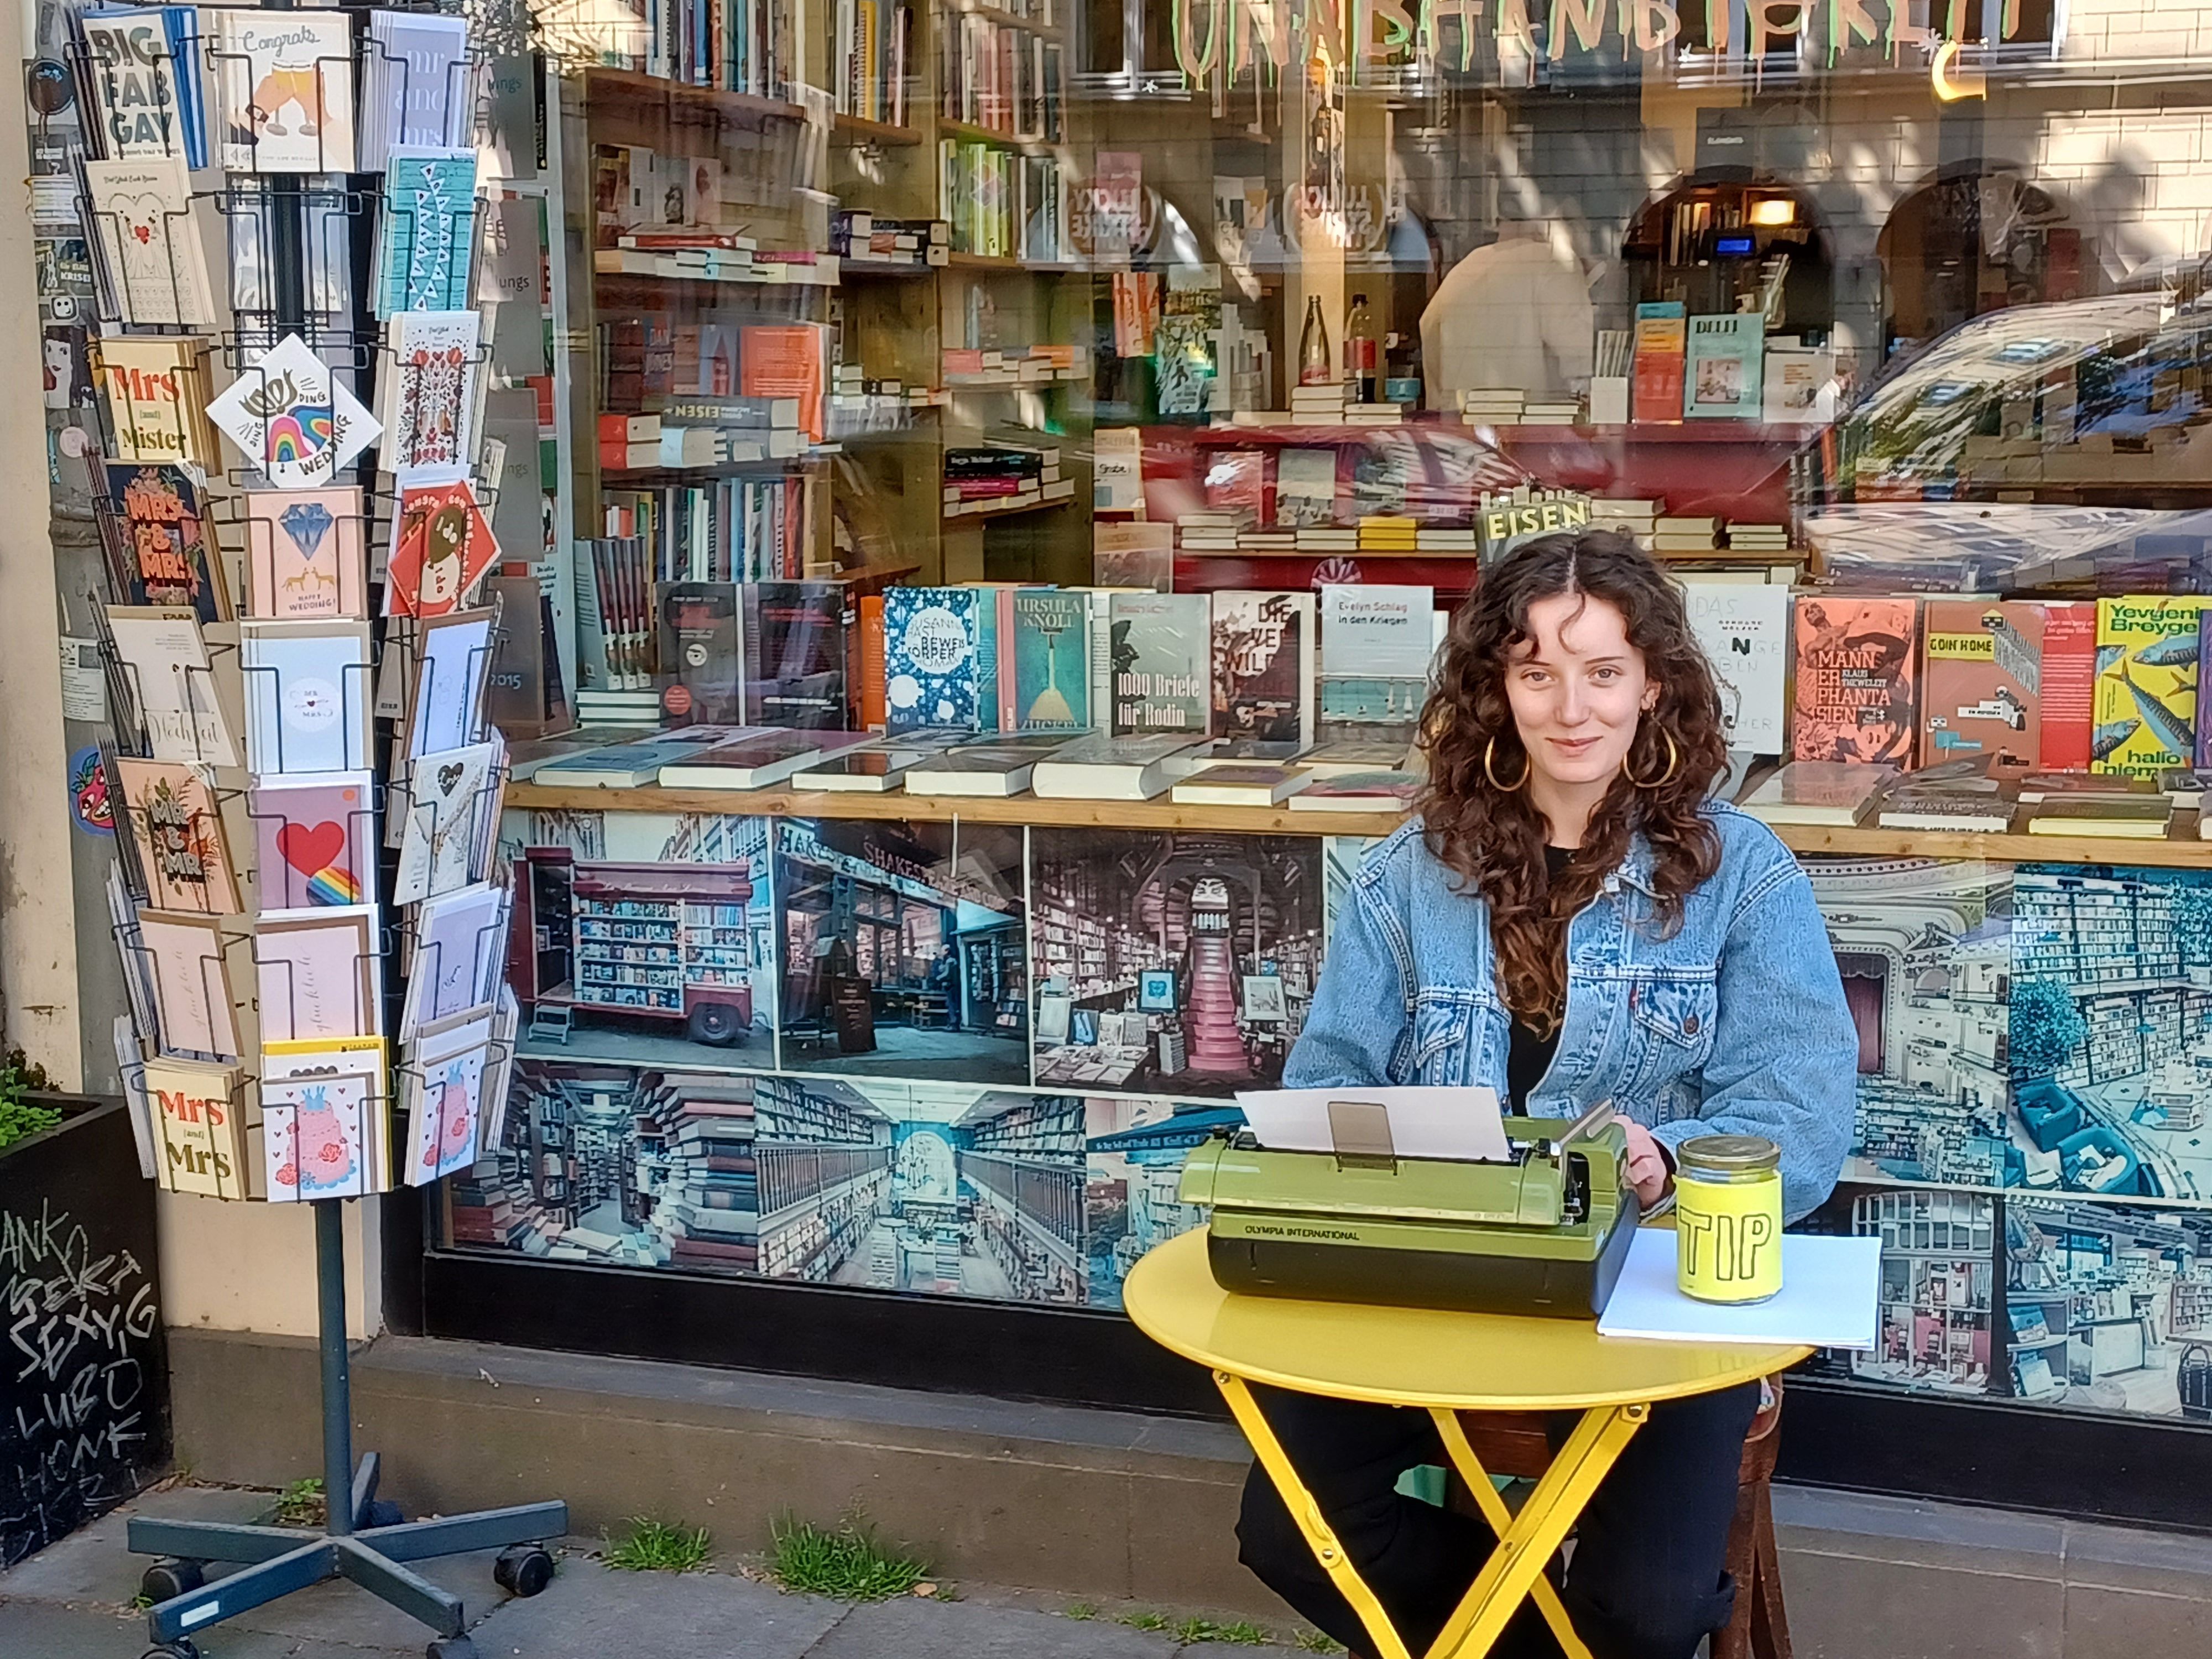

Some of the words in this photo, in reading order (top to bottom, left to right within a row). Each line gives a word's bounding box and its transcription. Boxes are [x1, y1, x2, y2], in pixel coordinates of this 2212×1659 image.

[90, 27, 161, 67] BIG
[238, 25, 320, 57] Congrats
[101, 71, 171, 107] FAB
[109, 111, 173, 144] GAY
[113, 367, 180, 402] Mrs
[299, 392, 326, 403] DING
[675, 405, 719, 418] EISEN
[121, 426, 186, 450] Mister
[128, 492, 184, 521] MRS
[1488, 501, 1586, 540] EISEN
[151, 523, 171, 550] &
[139, 552, 193, 579] MRS
[1016, 598, 1081, 614] URSULA
[1338, 602, 1371, 612] Evelyn
[1023, 613, 1076, 628] KNOLL
[1338, 615, 1347, 624] In
[921, 637, 966, 649] BEWEIS
[1960, 639, 1992, 652] HOME
[491, 674, 521, 690] 2015
[1118, 672, 1151, 697] 1000
[1155, 672, 1200, 697] Briefe
[1818, 669, 1840, 686] ER
[1841, 669, 1869, 678] KLAUS
[1817, 687, 1892, 706] PHANTA
[1118, 702, 1141, 726] für
[1145, 702, 1186, 727] Rodin
[1815, 706, 1857, 723] SIEN
[2127, 749, 2181, 765] hallo
[151, 800, 190, 825] MR
[166, 851, 202, 875] MR
[156, 1089, 223, 1126] Mrs
[166, 1141, 231, 1178] Mrs
[1244, 1225, 1284, 1236] OLYMPIA
[1287, 1228, 1360, 1241] INTERNATIONAL
[1679, 1204, 1772, 1281] TIP
